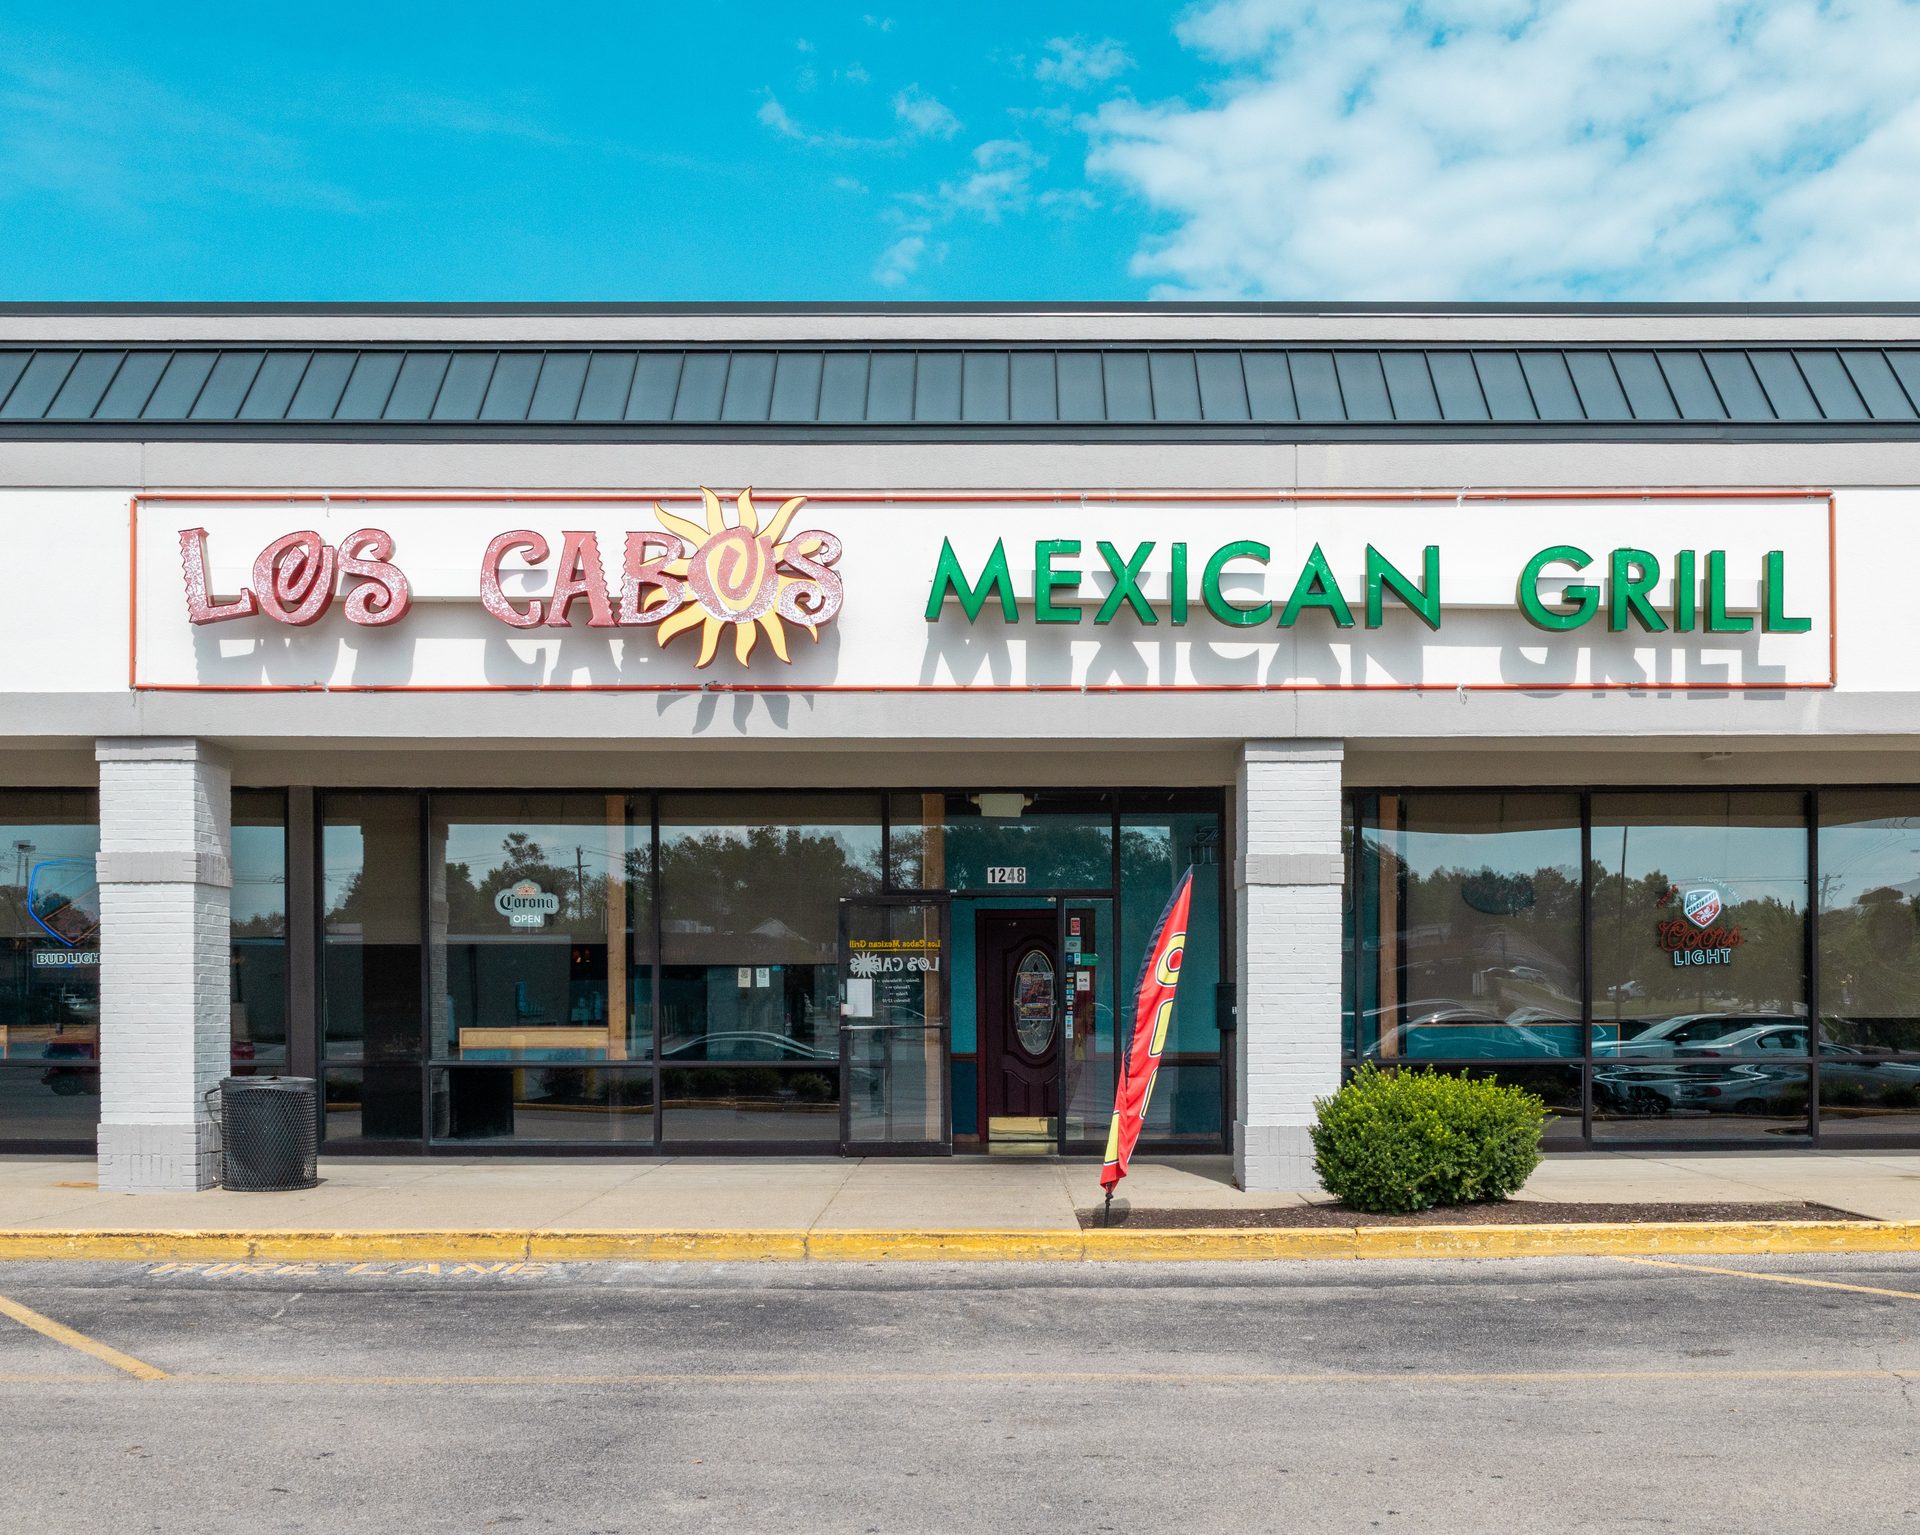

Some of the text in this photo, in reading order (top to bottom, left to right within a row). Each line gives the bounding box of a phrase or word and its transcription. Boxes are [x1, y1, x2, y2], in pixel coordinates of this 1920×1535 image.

[178, 526, 844, 628] LOS CABOS
[924, 536, 1812, 635] MEXICAN GRILL
[989, 868, 1025, 883] 1248
[499, 894, 554, 912] Corona
[512, 914, 541, 923] OPEN
[1659, 920, 1744, 952] Coors
[36, 952, 100, 965] BUD LIGH
[1674, 949, 1732, 966] LIGHT
[344, 1262, 549, 1275] LANE
